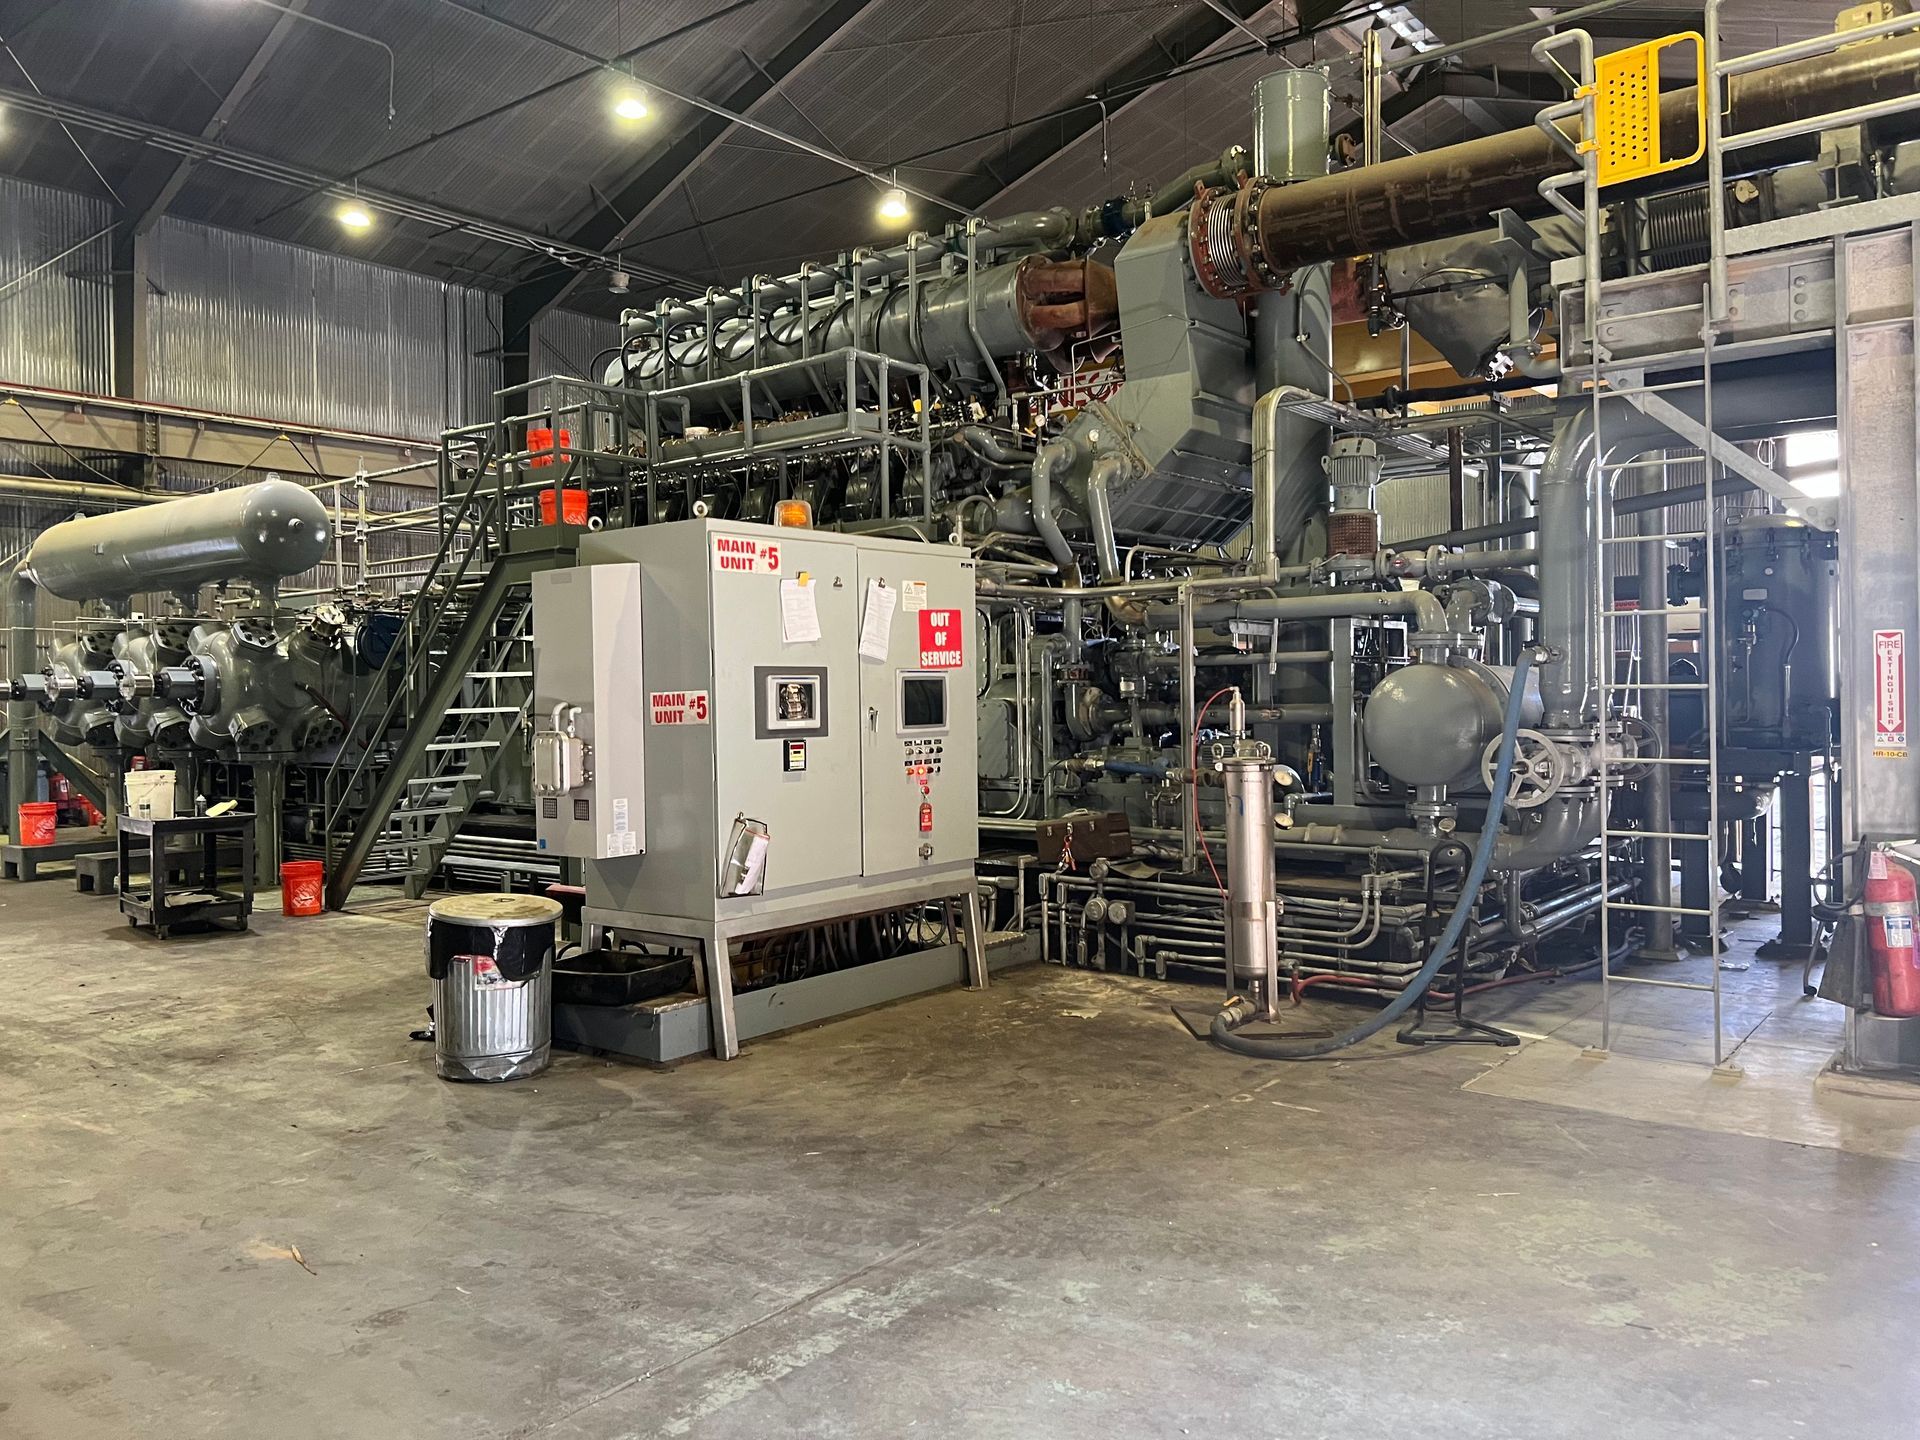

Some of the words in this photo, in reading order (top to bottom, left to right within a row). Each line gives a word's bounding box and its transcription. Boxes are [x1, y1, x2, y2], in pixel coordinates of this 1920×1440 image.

[717, 538, 756, 554] MAIN
[720, 556, 754, 570] UNIT
[760, 546, 779, 570] #5
[930, 612, 950, 627] OUT
[934, 631, 947, 646] OF
[1879, 640, 1900, 649] FIRE
[921, 650, 961, 666] SERVICE
[652, 693, 686, 707] MAIN
[689, 696, 707, 720] #5
[655, 710, 684, 723] UNIT
